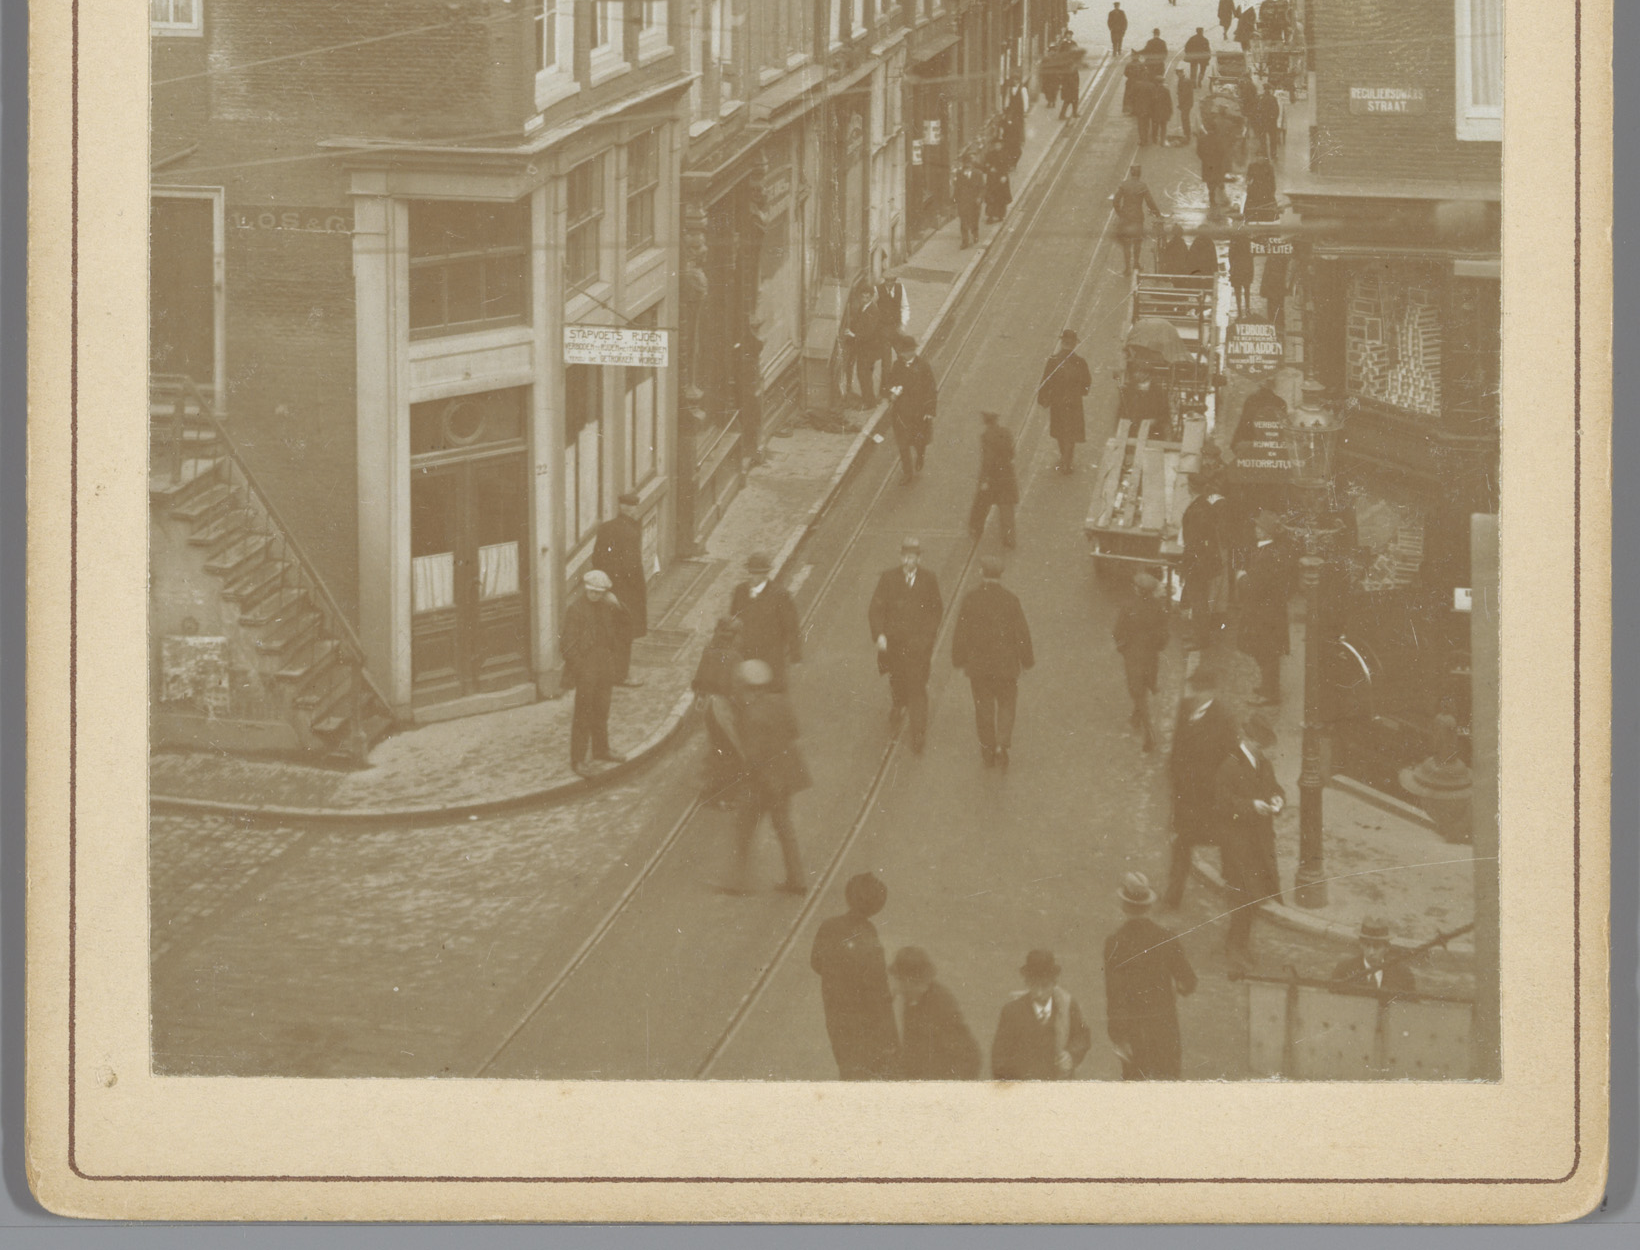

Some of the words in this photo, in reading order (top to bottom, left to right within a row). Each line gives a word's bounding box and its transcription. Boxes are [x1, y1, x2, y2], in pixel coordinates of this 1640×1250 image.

[568, 329, 624, 342] STAPVOETS
[1235, 323, 1276, 337] VERBODEN
[1227, 341, 1283, 355] HANDKARREN
[1253, 421, 1284, 429] VERBO
